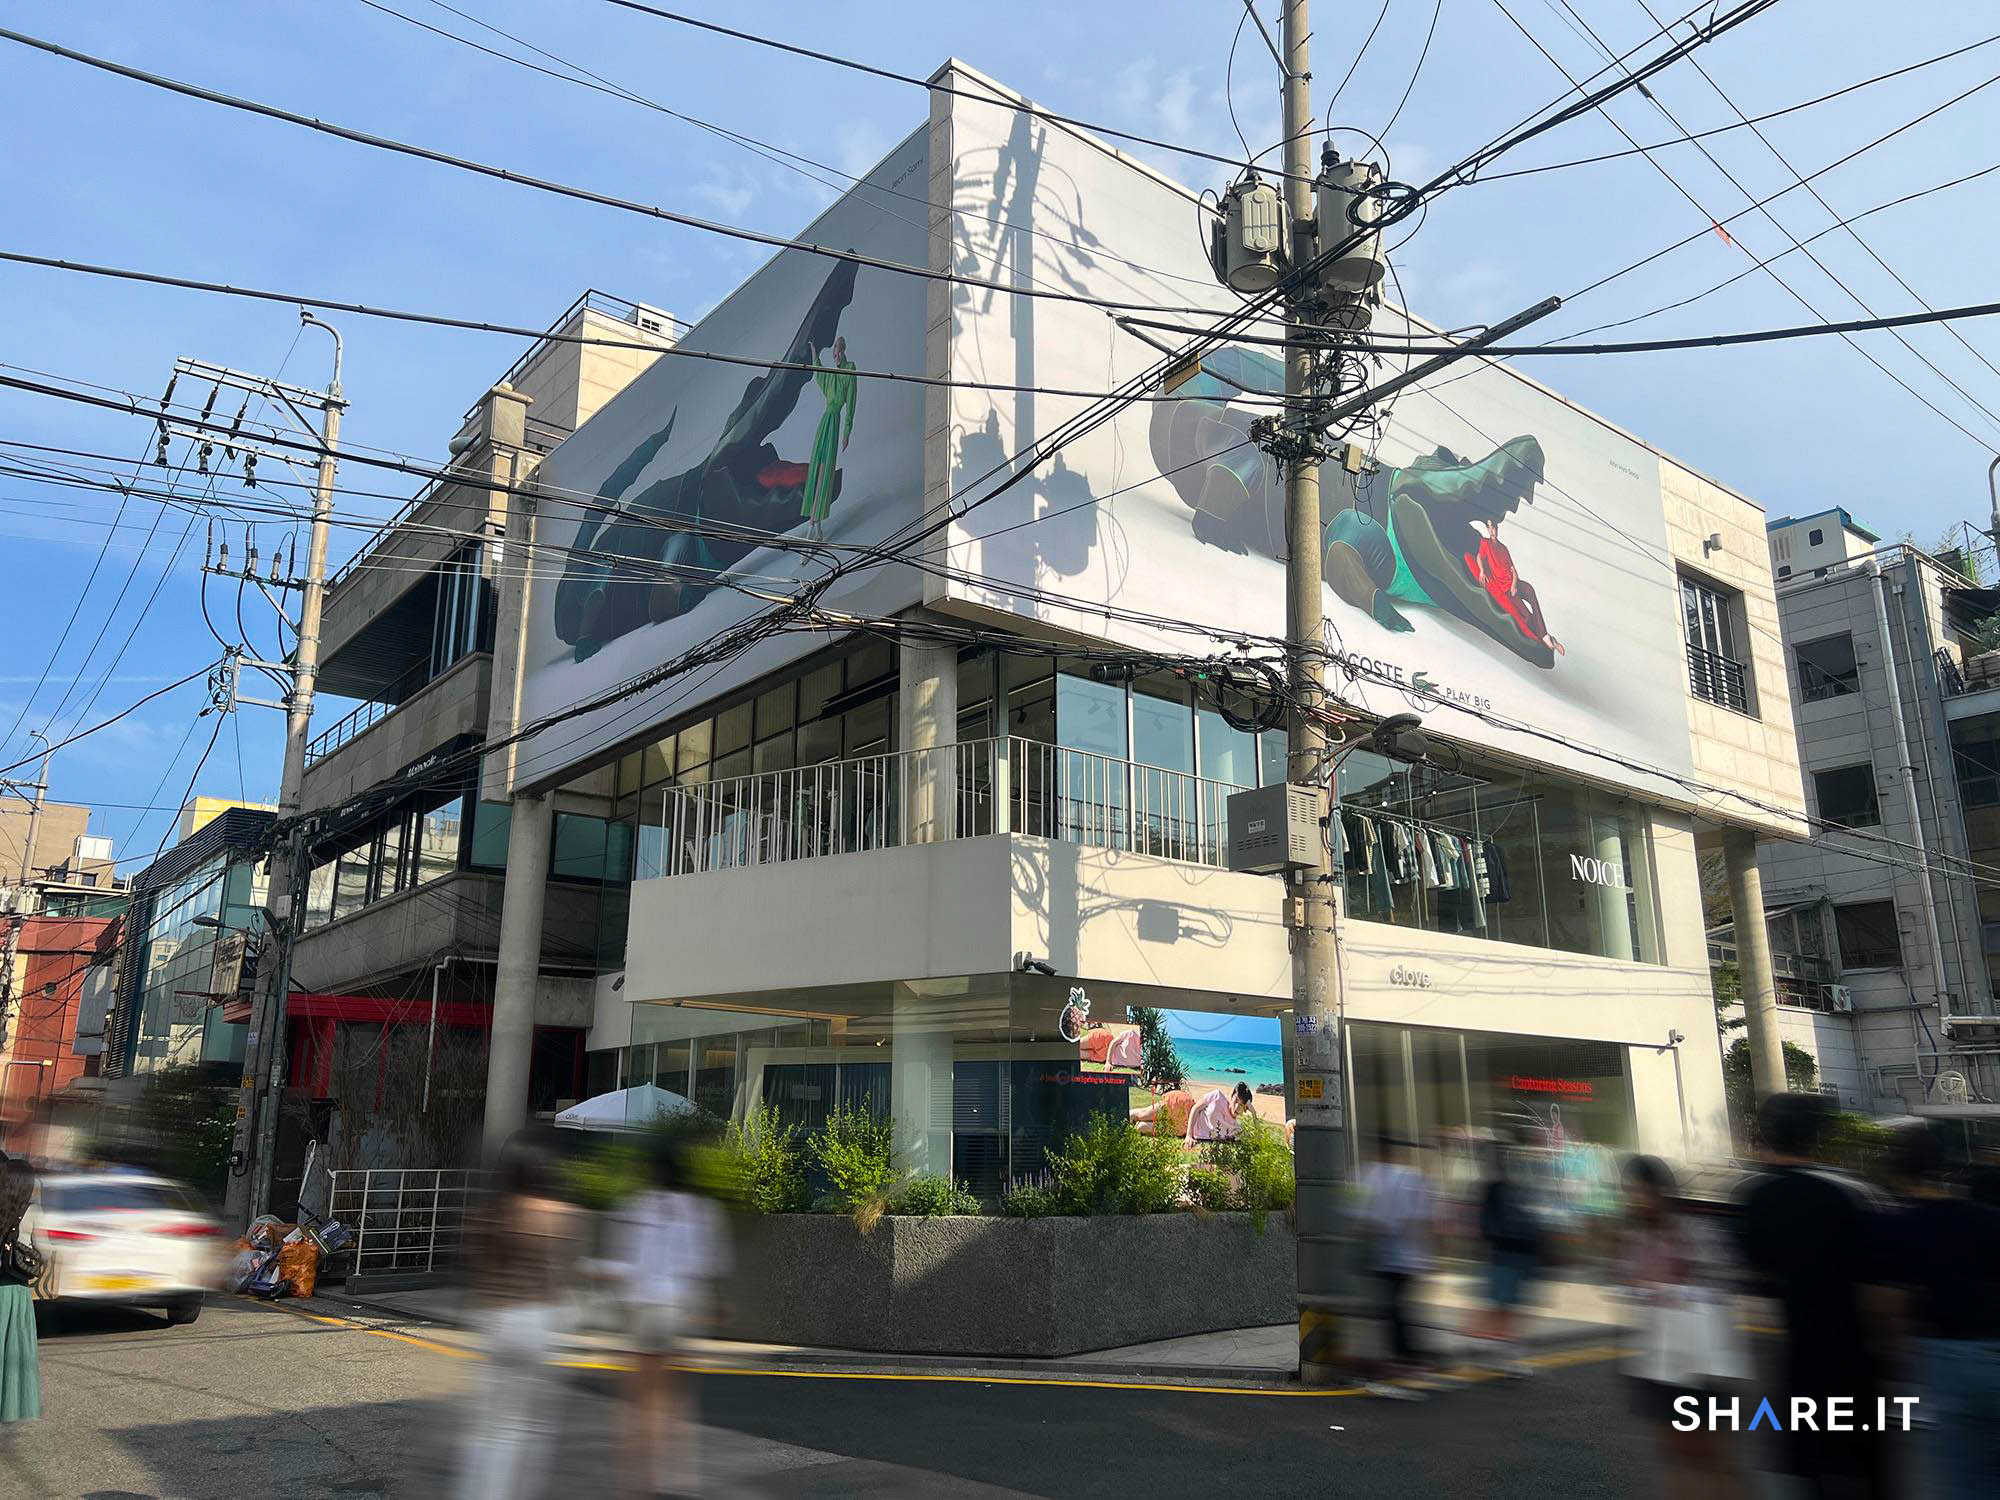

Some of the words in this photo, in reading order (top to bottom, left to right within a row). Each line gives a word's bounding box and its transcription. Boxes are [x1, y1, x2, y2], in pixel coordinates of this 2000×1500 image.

[1446, 687, 1471, 704] PLAY
[1474, 696, 1491, 710] BIG
[1569, 853, 1625, 889] NOICE
[1558, 1078, 1593, 1094] Seasons
